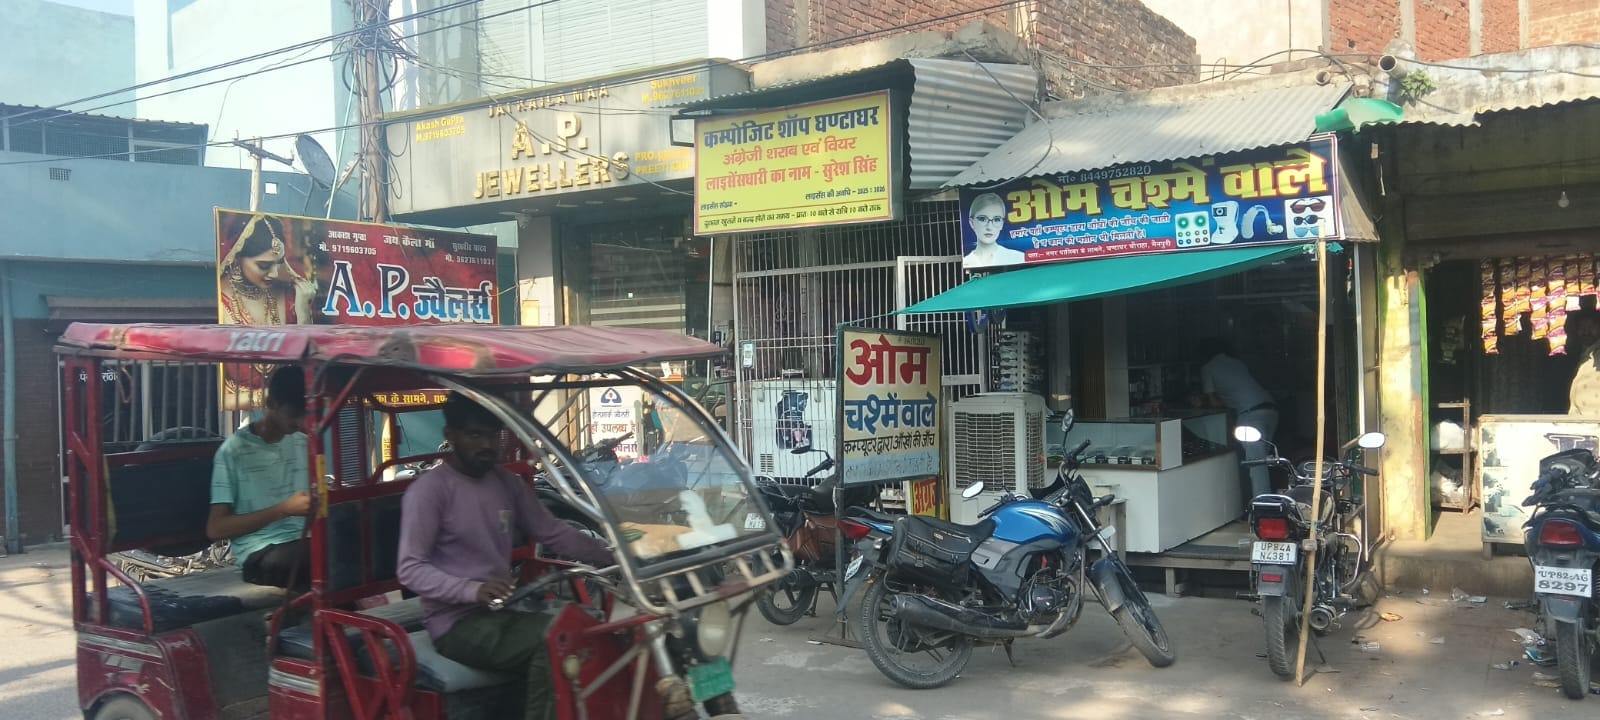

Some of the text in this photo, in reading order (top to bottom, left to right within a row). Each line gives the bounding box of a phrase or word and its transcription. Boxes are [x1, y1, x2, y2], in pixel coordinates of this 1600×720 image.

[573, 85, 609, 102] MAA
[511, 112, 588, 160] A.P.
[704, 106, 880, 149] कम्पोजिट शॉप घण्टाघर
[723, 144, 762, 165] अंग्रेजी
[801, 137, 822, 156] एवं
[473, 151, 630, 199] JEWELLERS
[705, 154, 879, 191] लाइसेंसधारी का नाम सुरेश सिंह
[1007, 178, 1102, 224] ओम
[1220, 147, 1328, 200] वाले
[1080, 164, 1152, 183] 8449752820
[383, 234, 399, 247] जय
[321, 260, 410, 320] A.P.
[411, 276, 494, 323] ज्वैलर्स
[845, 333, 931, 386] ओम
[901, 392, 938, 429] वाले
[391, 392, 400, 405] के
[600, 423, 628, 433] उपलब्ध
[876, 435, 894, 455] द्वारा
[912, 430, 922, 448] की
[1260, 552, 1290, 561] N4381
[1538, 580, 1589, 593] 8297
